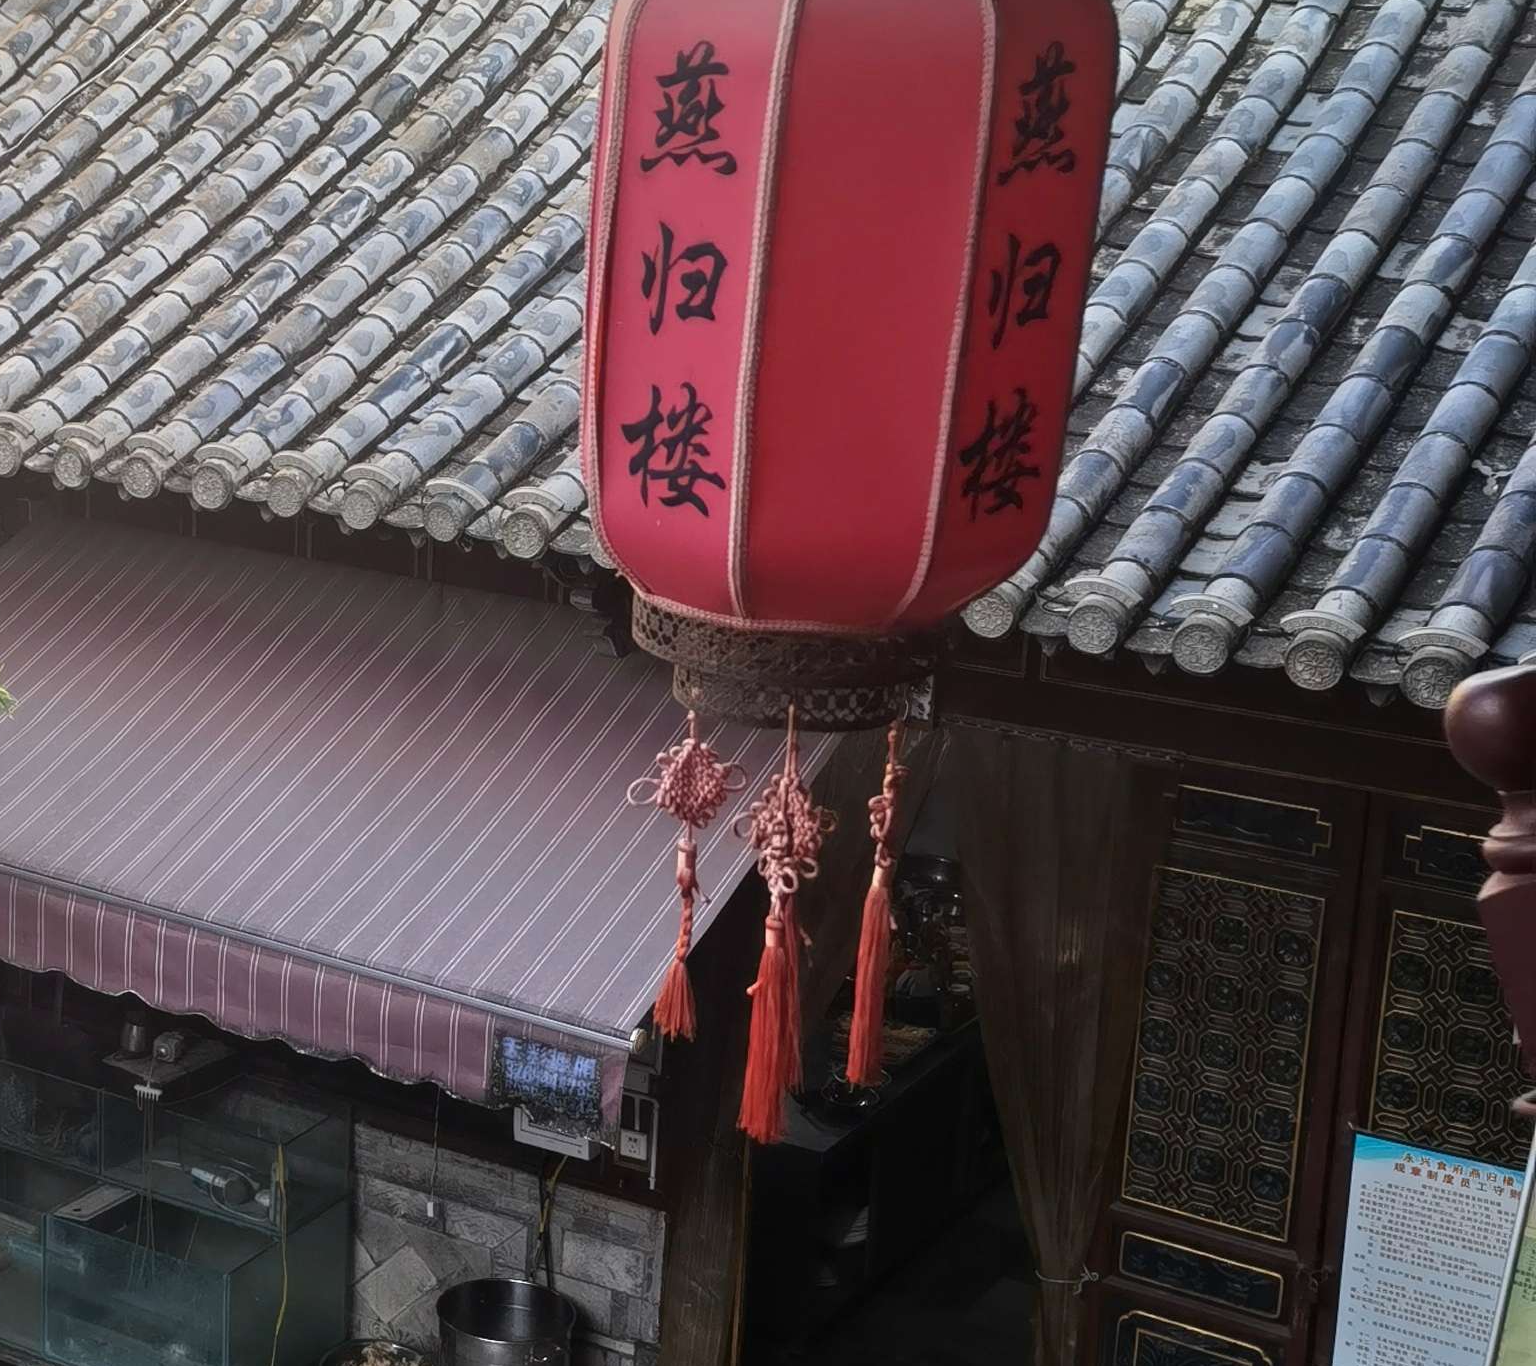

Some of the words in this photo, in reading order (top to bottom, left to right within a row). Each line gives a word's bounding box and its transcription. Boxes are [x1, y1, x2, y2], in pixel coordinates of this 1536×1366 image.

[621, 40, 738, 517] 燕归楼
[959, 42, 1077, 523] 燕归楼
